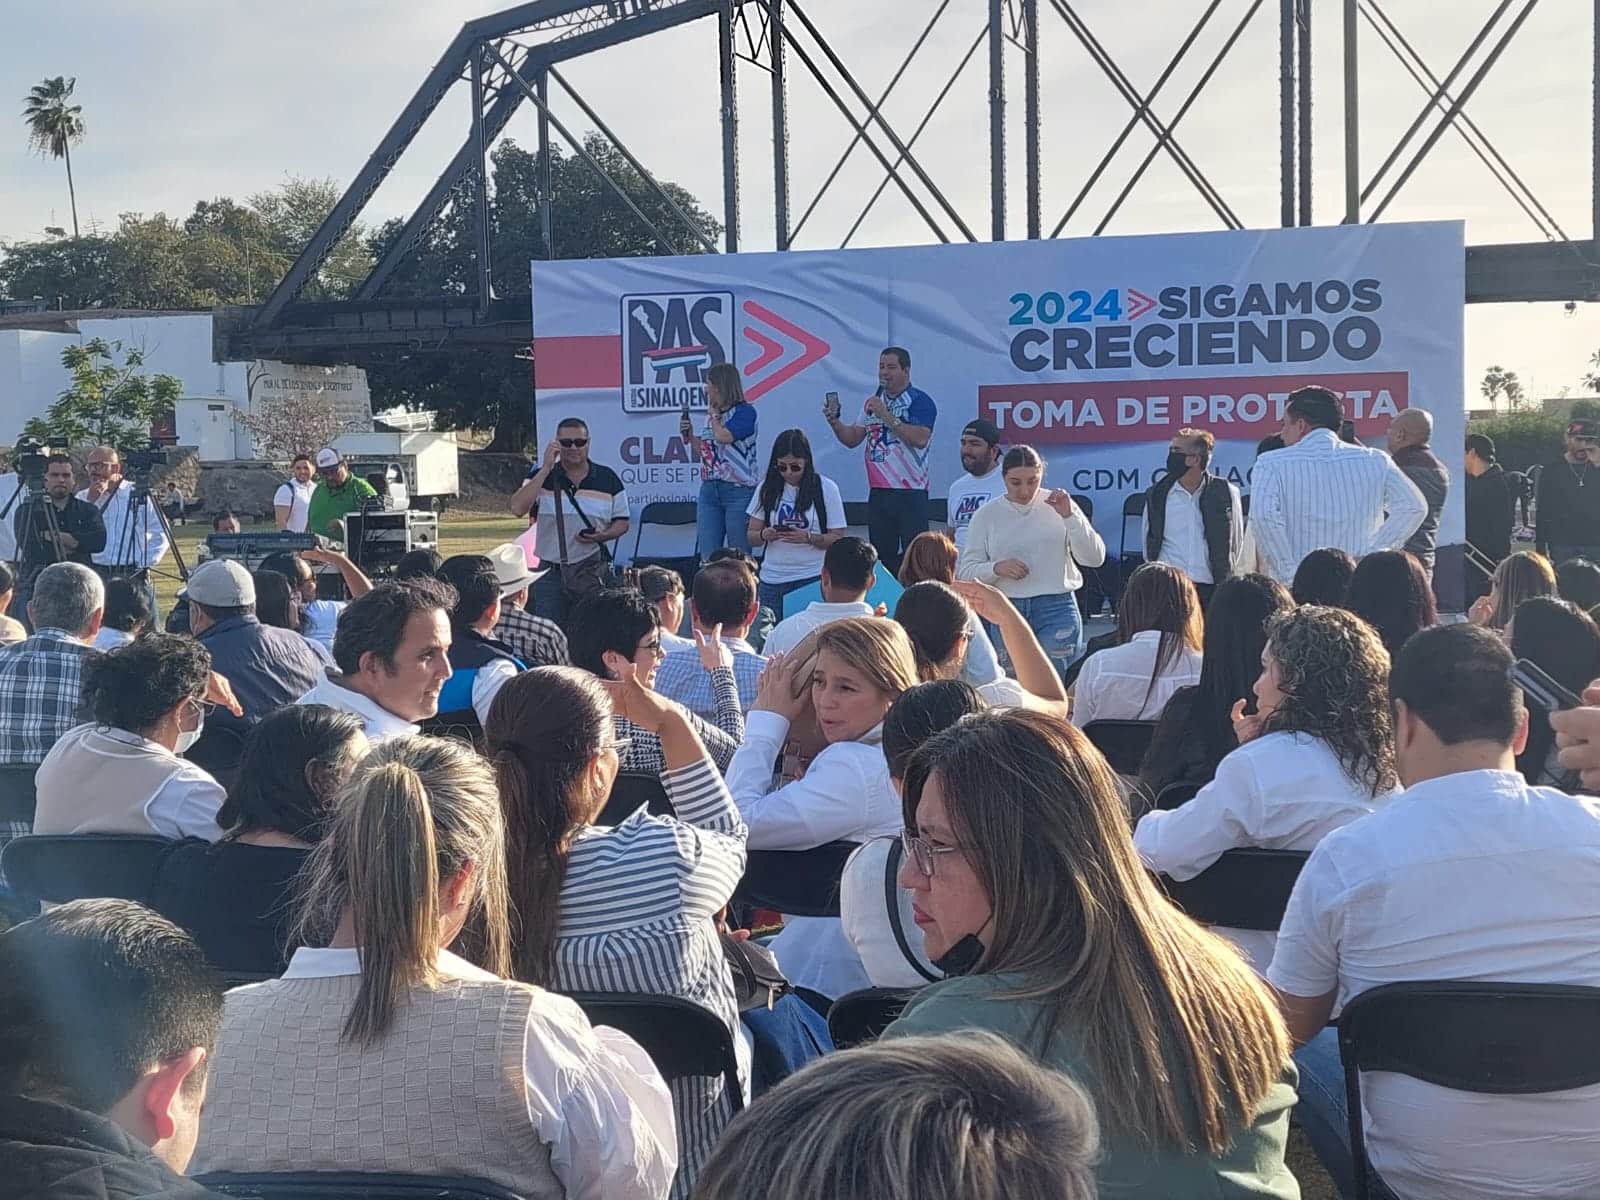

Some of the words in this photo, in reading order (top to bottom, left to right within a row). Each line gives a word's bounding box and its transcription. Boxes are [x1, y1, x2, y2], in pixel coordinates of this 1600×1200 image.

[1008, 288, 1122, 325] 2024
[1157, 278, 1383, 320] SIGAMOS
[628, 296, 726, 385] PAS
[1009, 315, 1382, 373] CRECIENDO
[637, 386, 708, 408] SINALOEN
[988, 397, 1105, 430] TOMA
[1116, 395, 1170, 426] DE
[1182, 389, 1400, 424] PROTTA
[620, 467, 659, 485] QUE
[665, 467, 685, 483] SE
[1072, 468, 1140, 491] CDM
